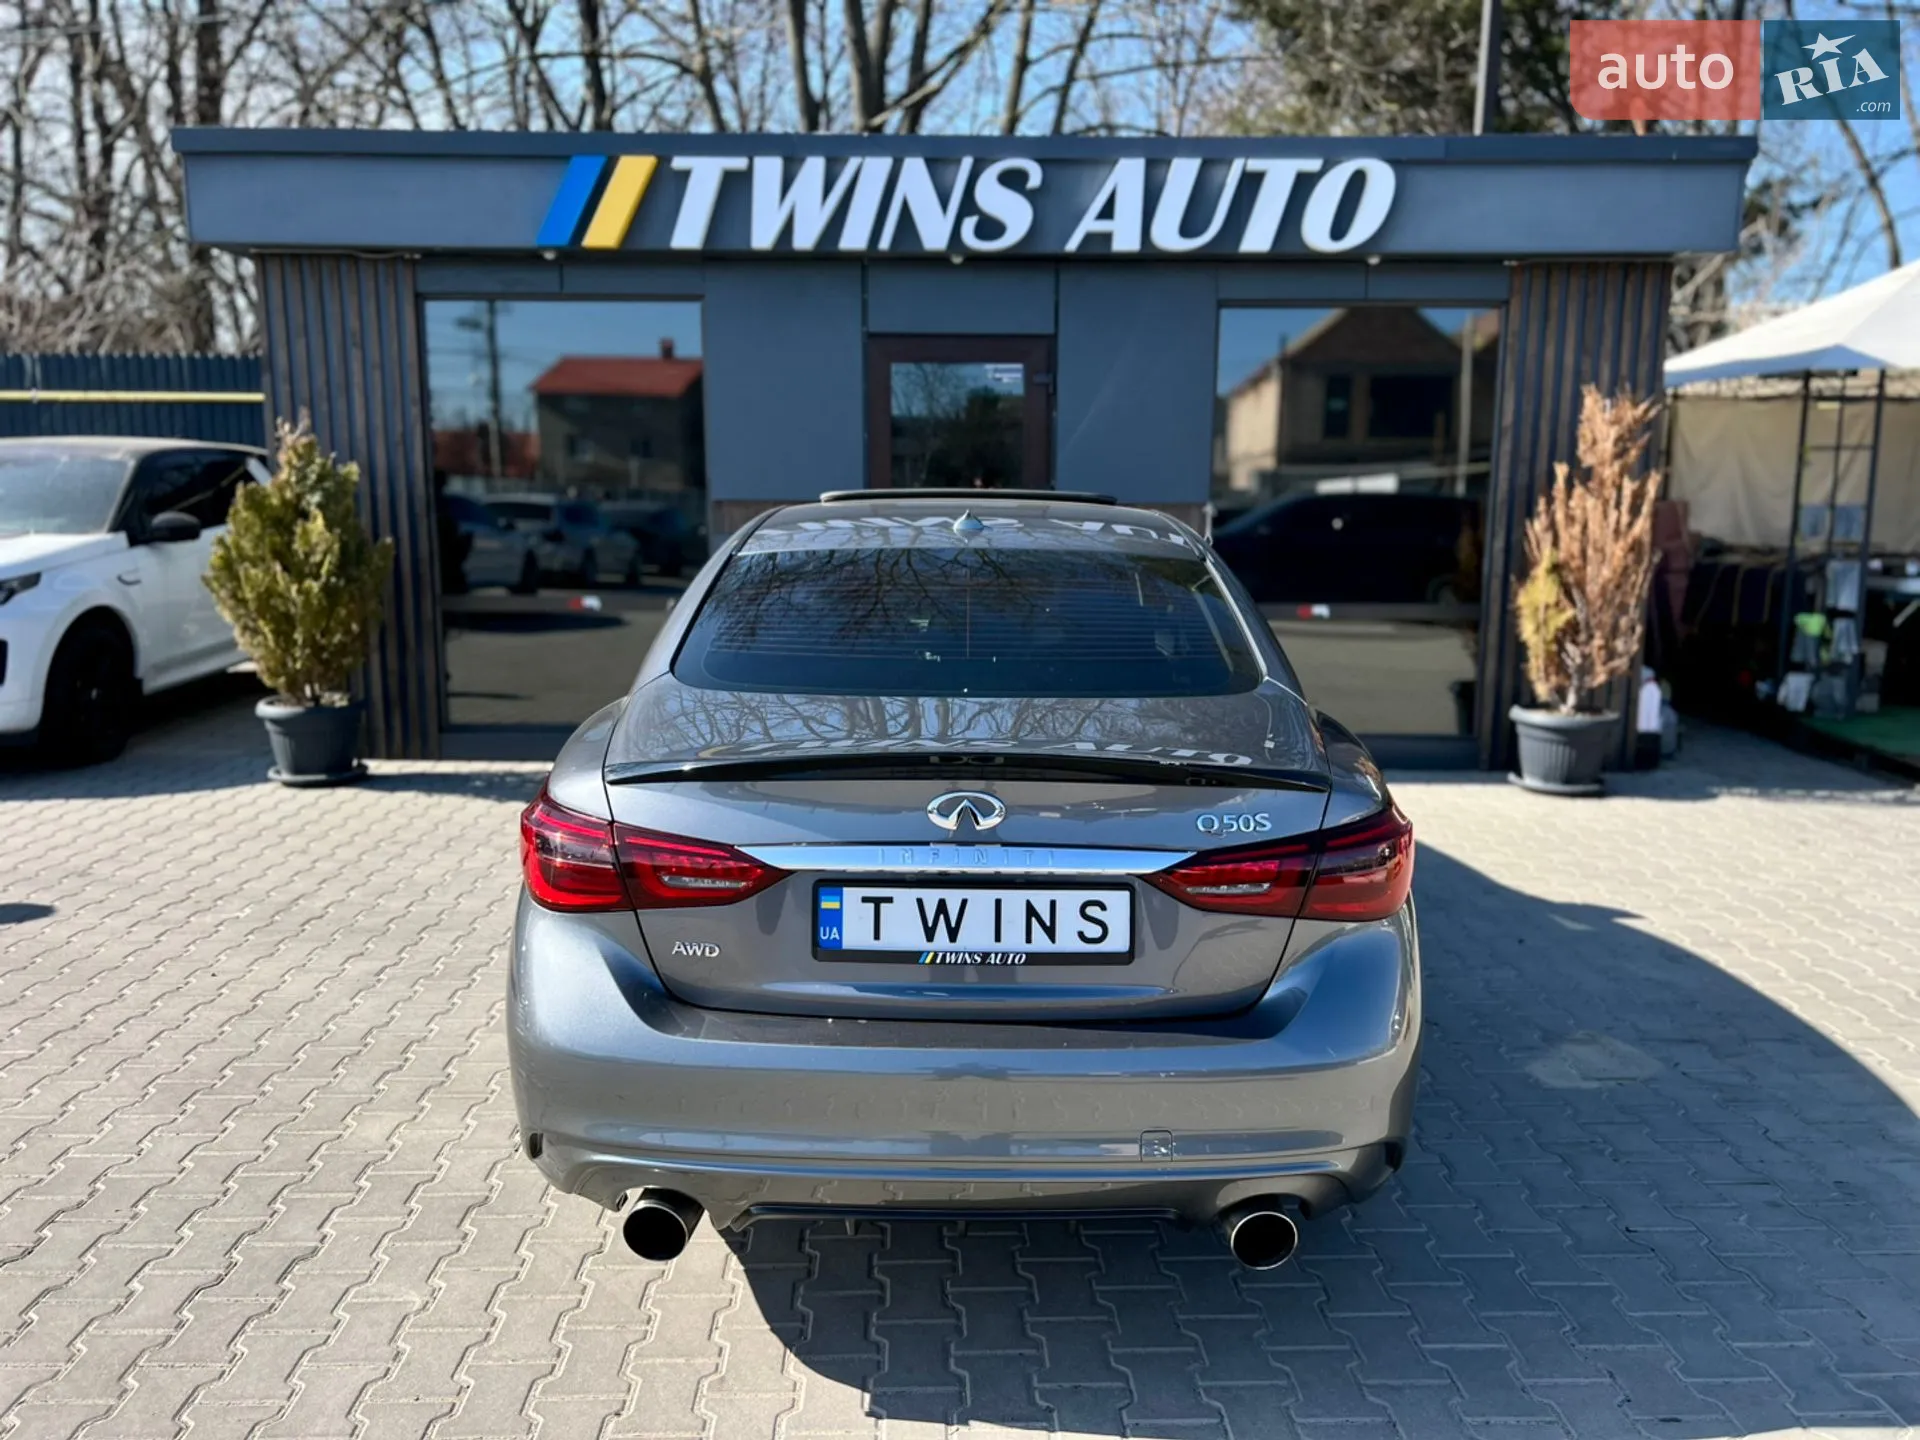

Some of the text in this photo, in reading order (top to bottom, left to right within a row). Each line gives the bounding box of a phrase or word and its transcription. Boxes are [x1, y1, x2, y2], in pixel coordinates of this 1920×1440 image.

[669, 154, 1397, 254] TWINS AUTO
[1197, 812, 1272, 838] Q50S
[878, 847, 1055, 866] INFINITI
[861, 896, 1109, 944] TWINS
[819, 927, 839, 940] UA
[671, 941, 720, 958] AWD
[935, 951, 1026, 966] TWINS AUTO
